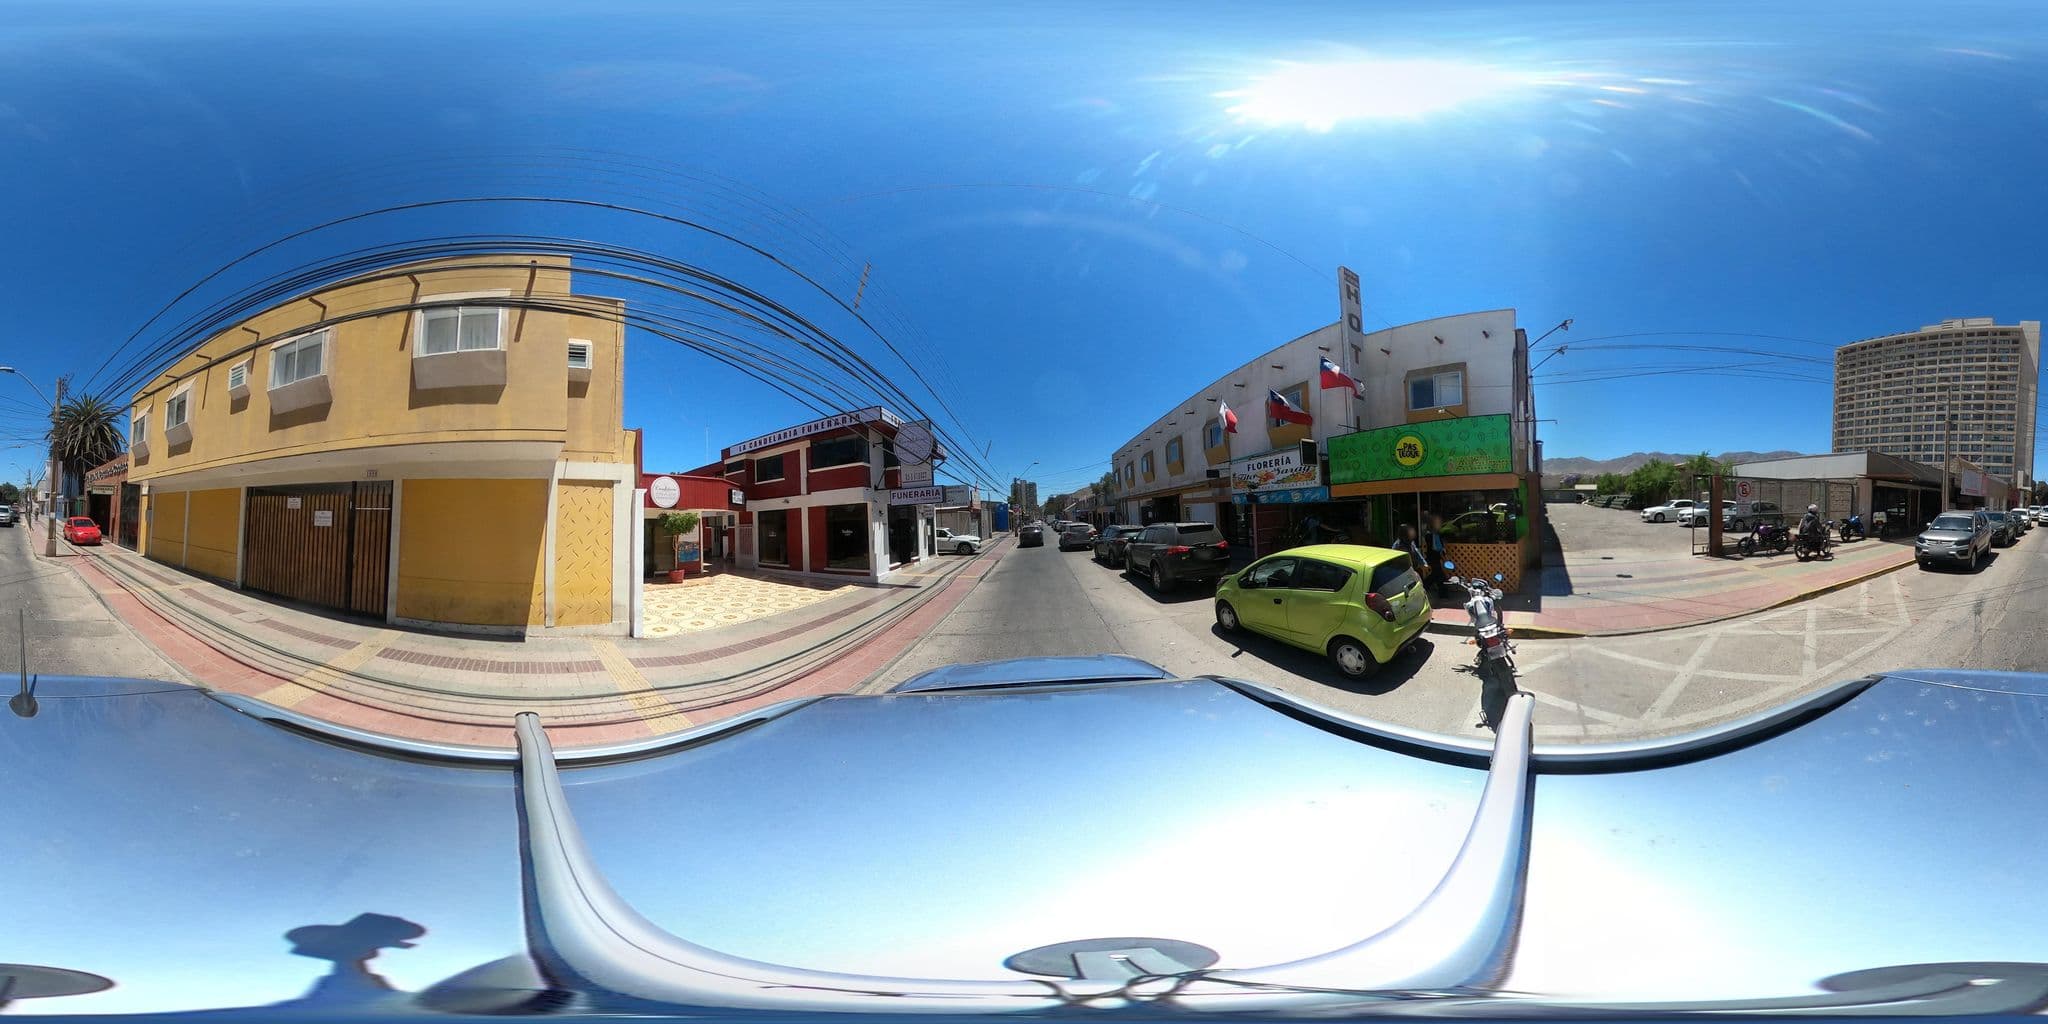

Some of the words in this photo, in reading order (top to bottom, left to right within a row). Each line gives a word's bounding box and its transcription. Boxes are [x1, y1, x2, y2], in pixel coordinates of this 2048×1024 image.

[739, 443, 747, 452] LA
[749, 428, 798, 449] CANDELARIA
[801, 413, 861, 435] FUNERARIA
[1403, 442, 1417, 451] PAS
[1247, 456, 1291, 472] FLORERÍA
[891, 489, 941, 500] FUNERARIA
